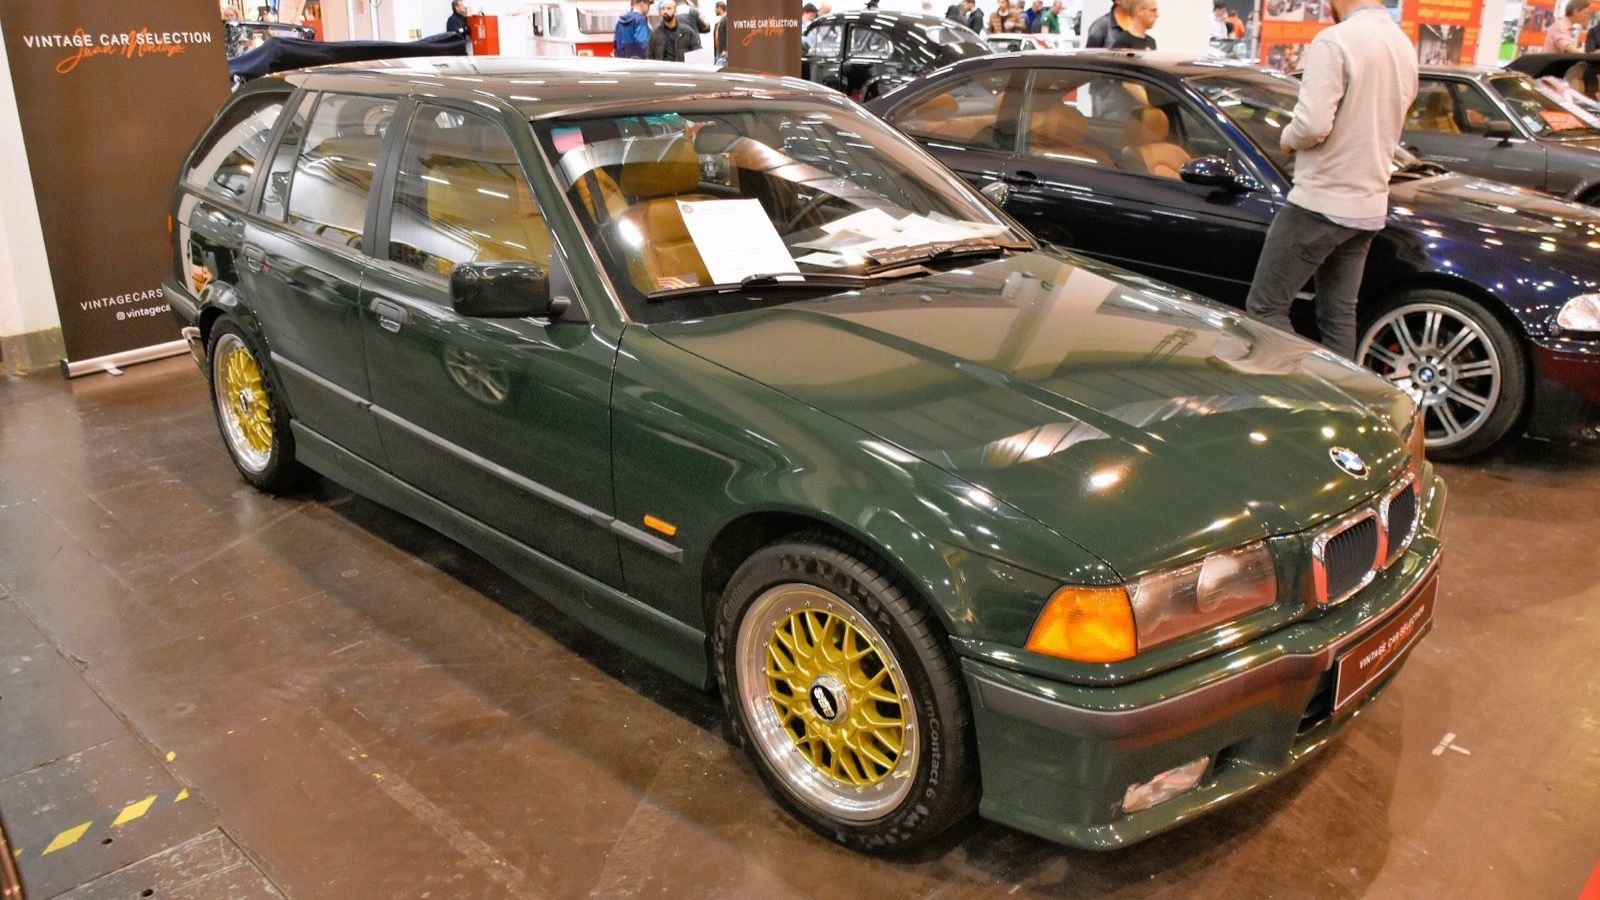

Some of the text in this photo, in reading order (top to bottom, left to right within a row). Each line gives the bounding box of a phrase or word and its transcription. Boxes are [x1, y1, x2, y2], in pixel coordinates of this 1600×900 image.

[734, 19, 798, 29] VINTAGE CAR SELECTION
[23, 31, 212, 48] VINTAGE CAR SELECTION
[80, 288, 164, 311] VINTAGECARS
